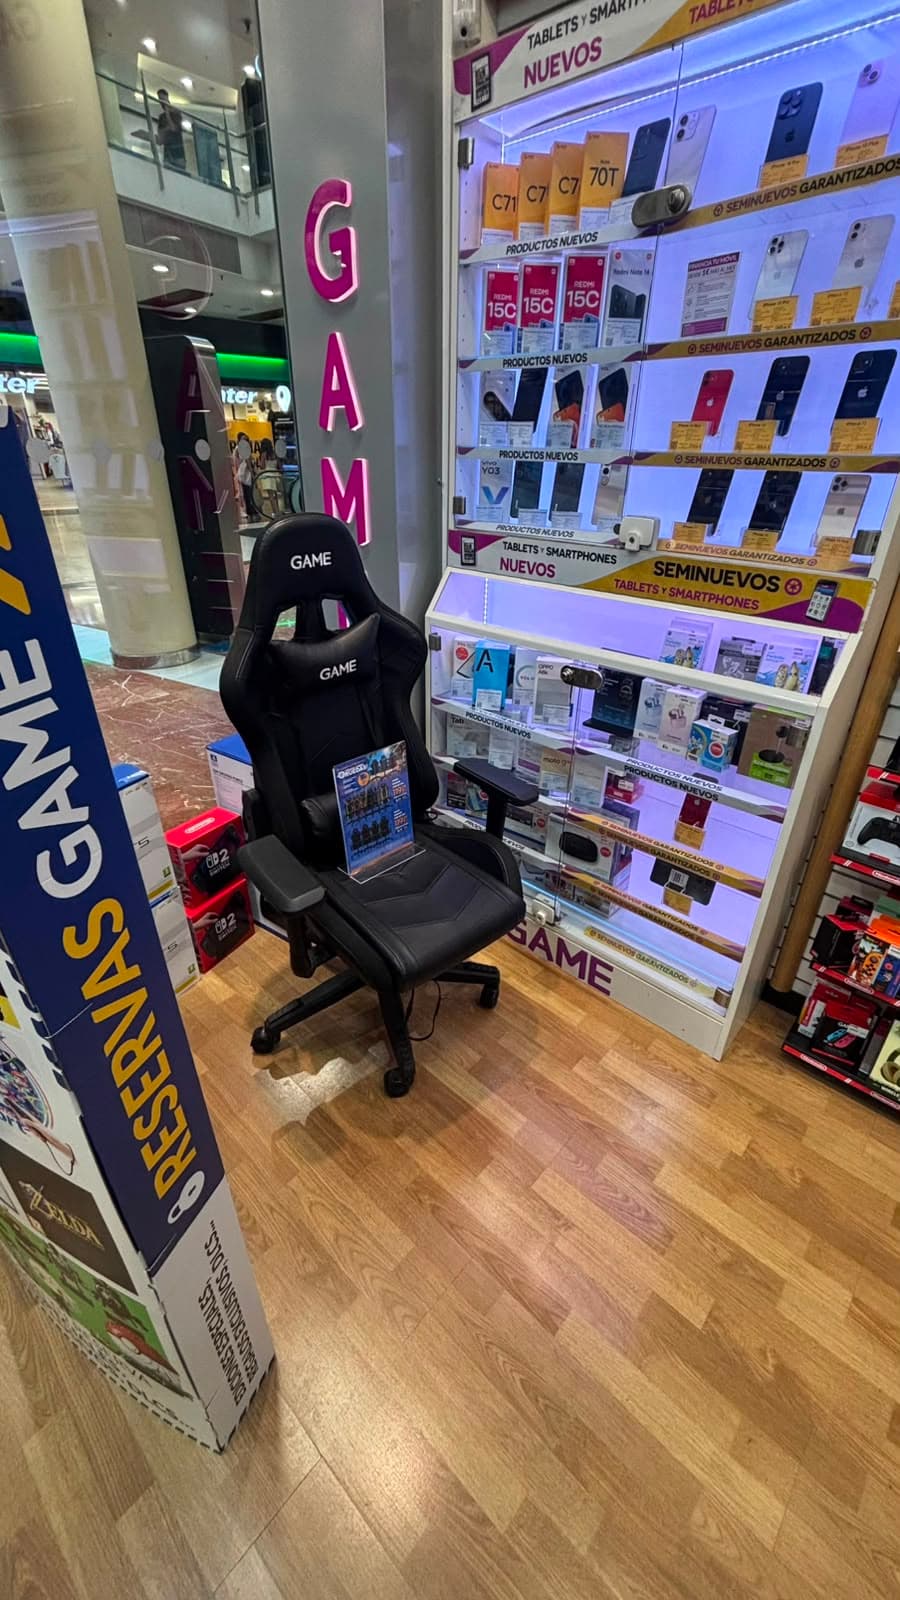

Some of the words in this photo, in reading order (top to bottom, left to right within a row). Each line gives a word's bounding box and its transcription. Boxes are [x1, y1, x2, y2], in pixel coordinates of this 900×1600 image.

[528, 16, 578, 50] TABLETS
[581, 15, 587, 26] Y
[524, 36, 603, 88] NUEVOS
[589, 167, 620, 187] 70T
[726, 184, 798, 214] SEMINUEVOS
[799, 156, 900, 195] GARANTIZADOS
[492, 194, 517, 212] C71
[526, 185, 549, 204] C7
[505, 238, 558, 256] PRODUCTOS
[558, 231, 599, 247] NUEVOS
[529, 287, 549, 295] REDMI
[573, 281, 595, 289] REDMI
[493, 293, 513, 302] REDMI
[523, 297, 554, 314] 15C
[567, 290, 600, 309] 15C
[487, 302, 517, 319] 15C
[699, 338, 762, 353] SEMINUEVOS
[764, 330, 856, 348] GARANTIZADOS
[502, 355, 551, 369] PRODUCTOS
[552, 352, 588, 365] NUEVOS
[499, 450, 545, 460] PRODUCTOS
[546, 451, 579, 461] NUEVOS
[684, 456, 743, 466] SEMINUEVOS
[744, 457, 827, 468] GARANTIZADOS
[496, 524, 541, 535] PRODUCTOS
[541, 528, 575, 538] NUEVOS
[290, 551, 332, 570] GAME
[503, 541, 539, 555] TABLETS
[545, 546, 617, 565] SMARTPHONES
[674, 542, 729, 556] SEMINUEVOS
[729, 550, 805, 565] GARANTIZADOS
[500, 557, 556, 578] NUEVOS
[653, 560, 781, 593] SEMINUEVOS
[614, 578, 660, 595] TABLETS
[661, 587, 668, 595] Y
[668, 587, 760, 611] SMARTPHONES
[319, 659, 358, 681] GAME
[476, 649, 494, 673] A
[465, 711, 504, 729] PRODUCTOS
[503, 723, 532, 739] NUEVOS
[0, 638, 102, 898] GAME
[626, 758, 682, 779] PRODUCTOS
[682, 772, 724, 792] NUEVOS
[624, 765, 678, 788] PRODUCTOS
[679, 781, 720, 801] NUEVOS
[650, 848, 711, 877] GARANTIZADOS
[653, 840, 715, 868] GARANTIZADOS
[507, 920, 614, 996] GAME
[635, 953, 689, 983] GARANTIZADOS
[62, 898, 197, 1200] RESERVAS
[220, 1345, 247, 1406] EDICIONES
